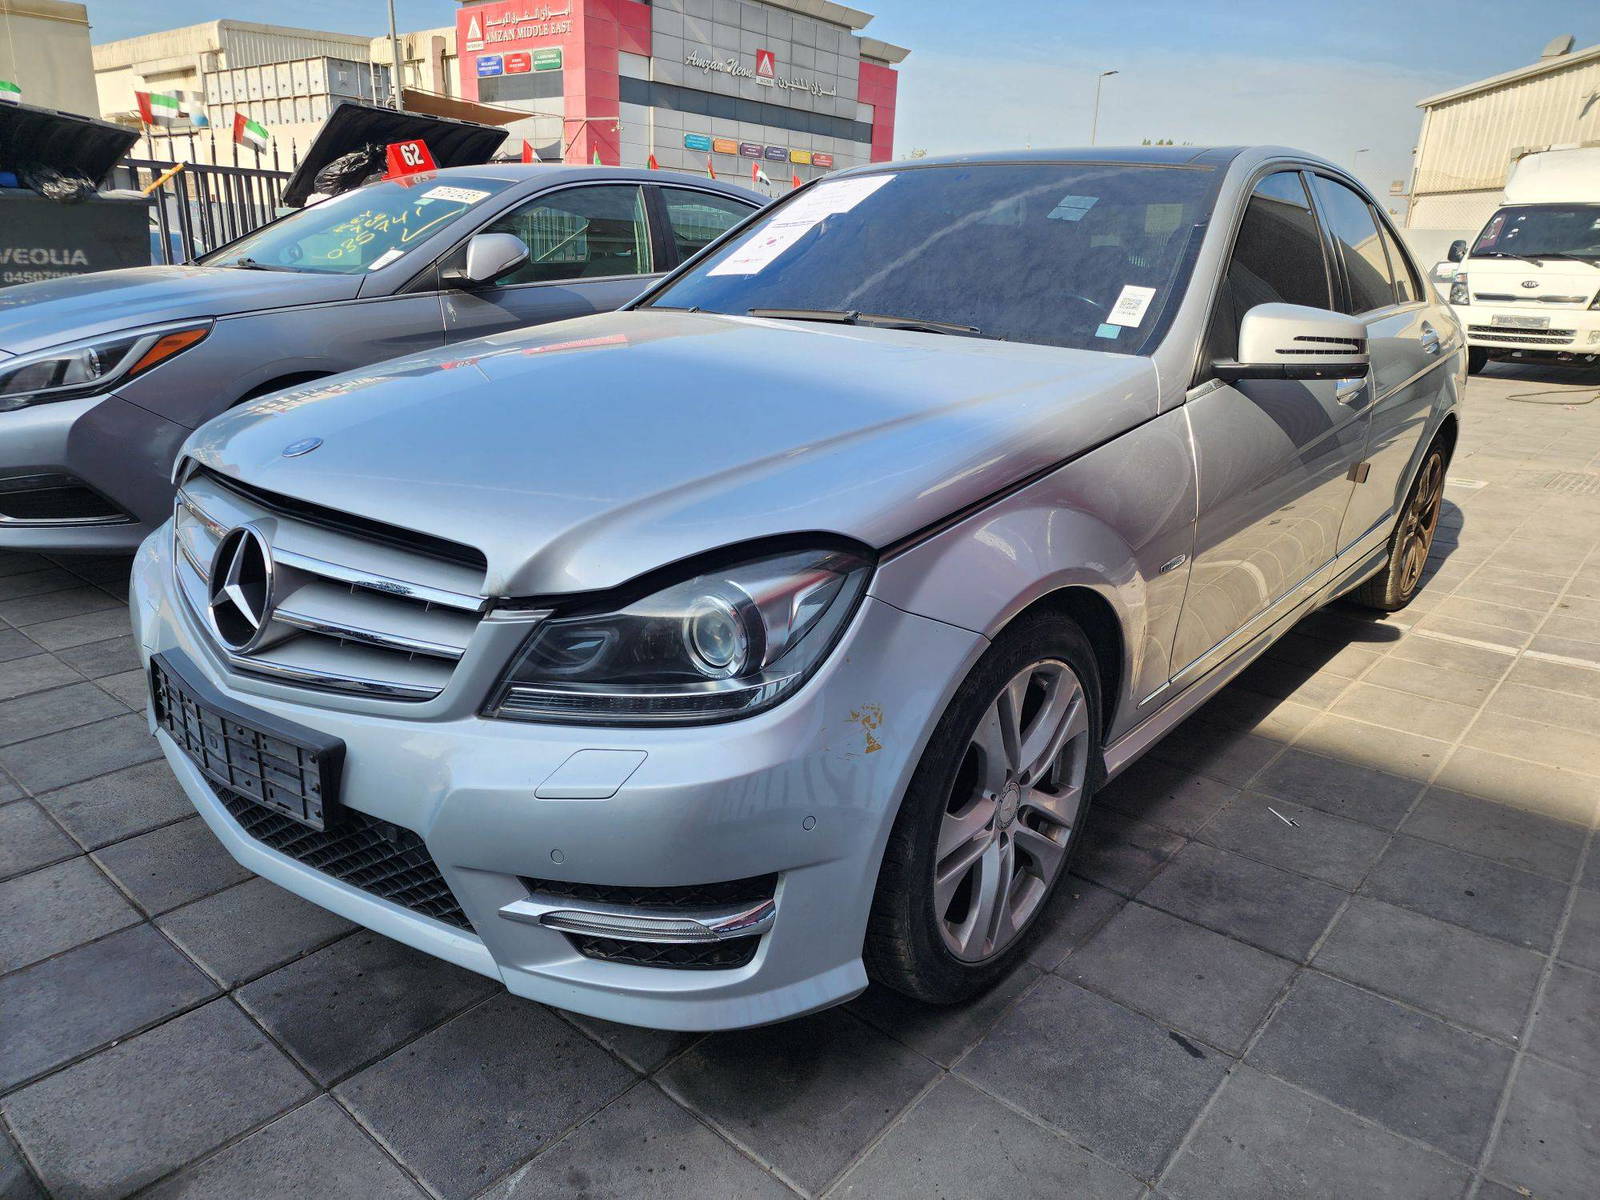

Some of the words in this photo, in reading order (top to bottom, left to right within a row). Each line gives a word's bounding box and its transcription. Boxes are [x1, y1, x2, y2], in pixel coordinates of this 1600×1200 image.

[486, 27, 516, 44] AMZAN
[518, 23, 550, 40] MIDDLE
[551, 20, 573, 36] EAST
[685, 49, 724, 74] Amzan
[725, 57, 753, 77] Neon
[400, 142, 425, 167] 62
[0, 247, 89, 266] VEOLIA
